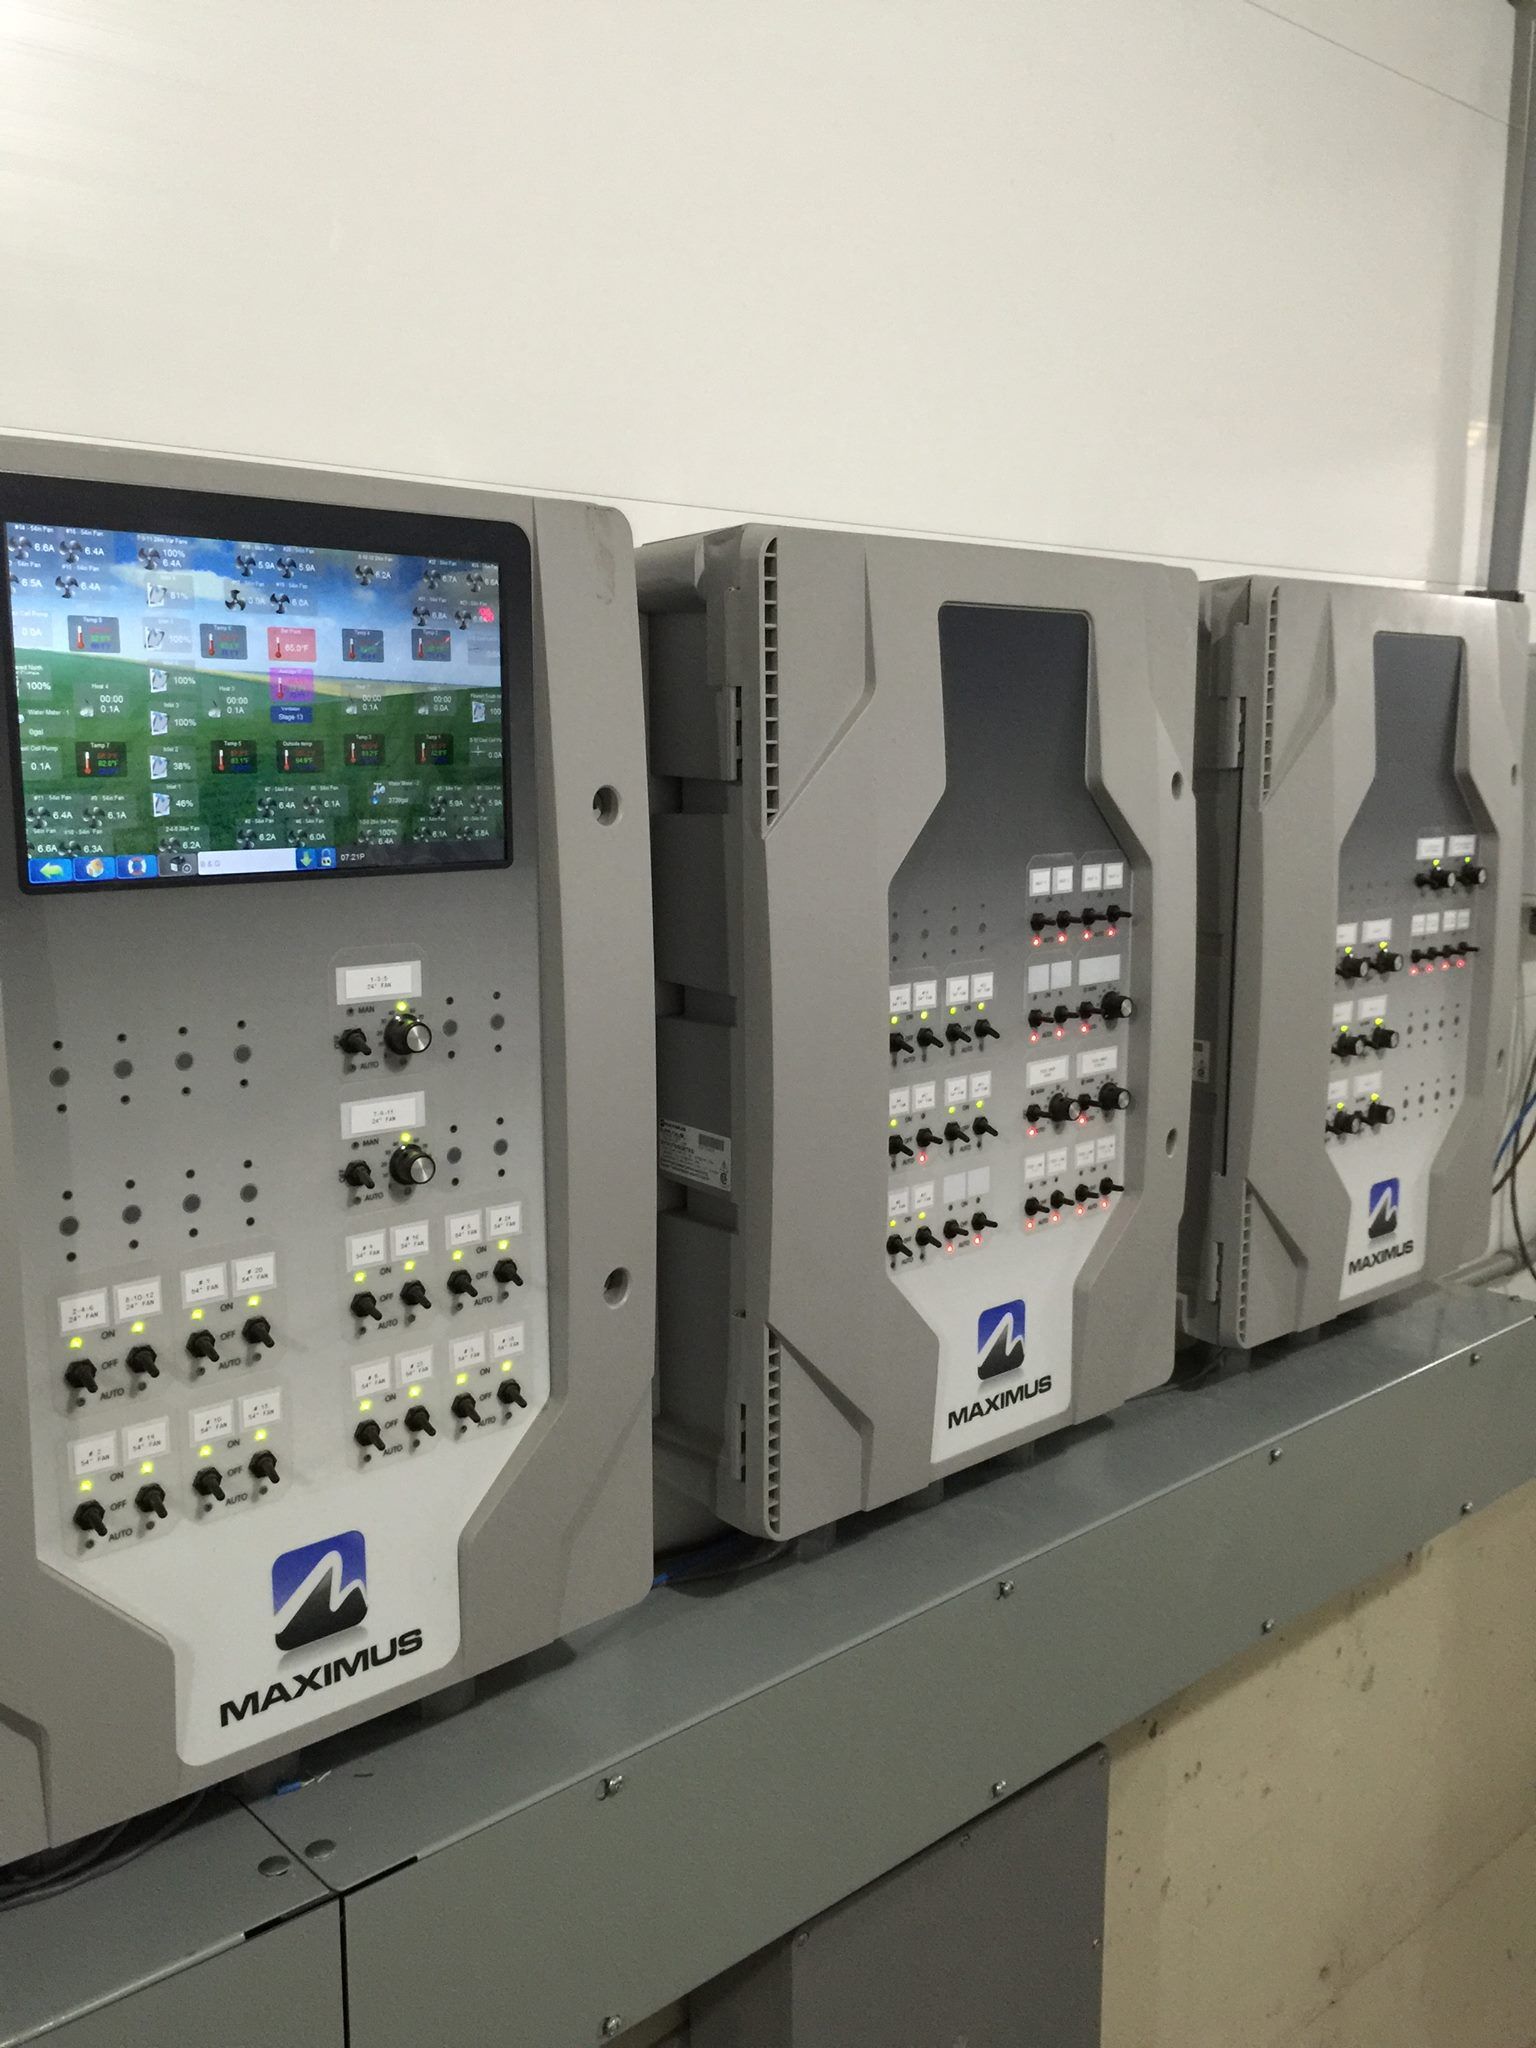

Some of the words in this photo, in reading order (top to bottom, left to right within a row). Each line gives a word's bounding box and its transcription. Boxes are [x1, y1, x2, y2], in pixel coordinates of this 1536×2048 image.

[34, 543, 56, 554] 6.6A
[84, 546, 105, 557] 6.4A
[162, 549, 185, 559] 100%
[162, 558, 182, 568] 6.4A
[21, 577, 43, 588] 6.5A
[80, 580, 101, 592] 6.4A
[173, 675, 197, 686] 100%
[26, 681, 52, 691] 100%
[100, 704, 121, 714] 0.1A
[226, 705, 245, 715] 0.1A
[173, 717, 197, 727] 100%
[278, 712, 296, 722] Stage
[90, 742, 105, 750] Temp
[224, 740, 237, 748] Temp
[31, 762, 52, 772] 0.1A
[173, 761, 192, 772] 38%
[278, 800, 296, 810] 6.4A
[324, 799, 342, 809] 6.1A
[52, 810, 74, 820] 6.4A
[107, 810, 127, 820] 6.1A
[258, 832, 277, 842] 6.2A
[309, 832, 327, 841] 6.0A
[37, 844, 58, 854] 6.6A
[83, 844, 104, 854] 6.3A
[182, 840, 201, 850] 6.2A
[358, 1005, 376, 1014] MAN
[360, 1060, 380, 1071] AUTO
[362, 1137, 380, 1147] MAN
[364, 1191, 385, 1202] AUTO
[475, 1245, 488, 1255] ON
[1348, 1239, 1414, 1276] MAXIMUS
[379, 1266, 392, 1276] ON
[475, 1270, 490, 1281] OFF
[206, 1283, 220, 1291] FAN
[379, 1291, 395, 1303] OFF
[473, 1295, 494, 1308] AUTO
[142, 1299, 155, 1307] FAN
[219, 1301, 234, 1312] ON
[85, 1311, 99, 1319] FAN
[377, 1318, 399, 1331] AUTO
[101, 1329, 116, 1340] ON
[219, 1329, 236, 1342] OFF
[101, 1358, 119, 1371] OFF
[218, 1357, 242, 1371] AUTO
[479, 1366, 491, 1376] ON
[100, 1386, 125, 1402] AUTO
[384, 1392, 397, 1402] ON
[478, 1391, 493, 1402] OFF
[948, 1375, 1052, 1430] MAXIMUS
[262, 1409, 275, 1417] FAN
[215, 1422, 228, 1430] FAN
[384, 1418, 400, 1431] OFF
[477, 1415, 497, 1429] AUTO
[148, 1440, 162, 1448] FAN
[226, 1438, 241, 1449] ON
[382, 1443, 404, 1458] AUTO
[97, 1453, 110, 1463] FAN
[109, 1471, 124, 1482] ON
[226, 1465, 243, 1478] OFF
[225, 1492, 249, 1507] AUTO
[109, 1499, 128, 1513] OFF
[108, 1527, 134, 1543] AUTO
[220, 1628, 424, 1728] MAXIMUS
